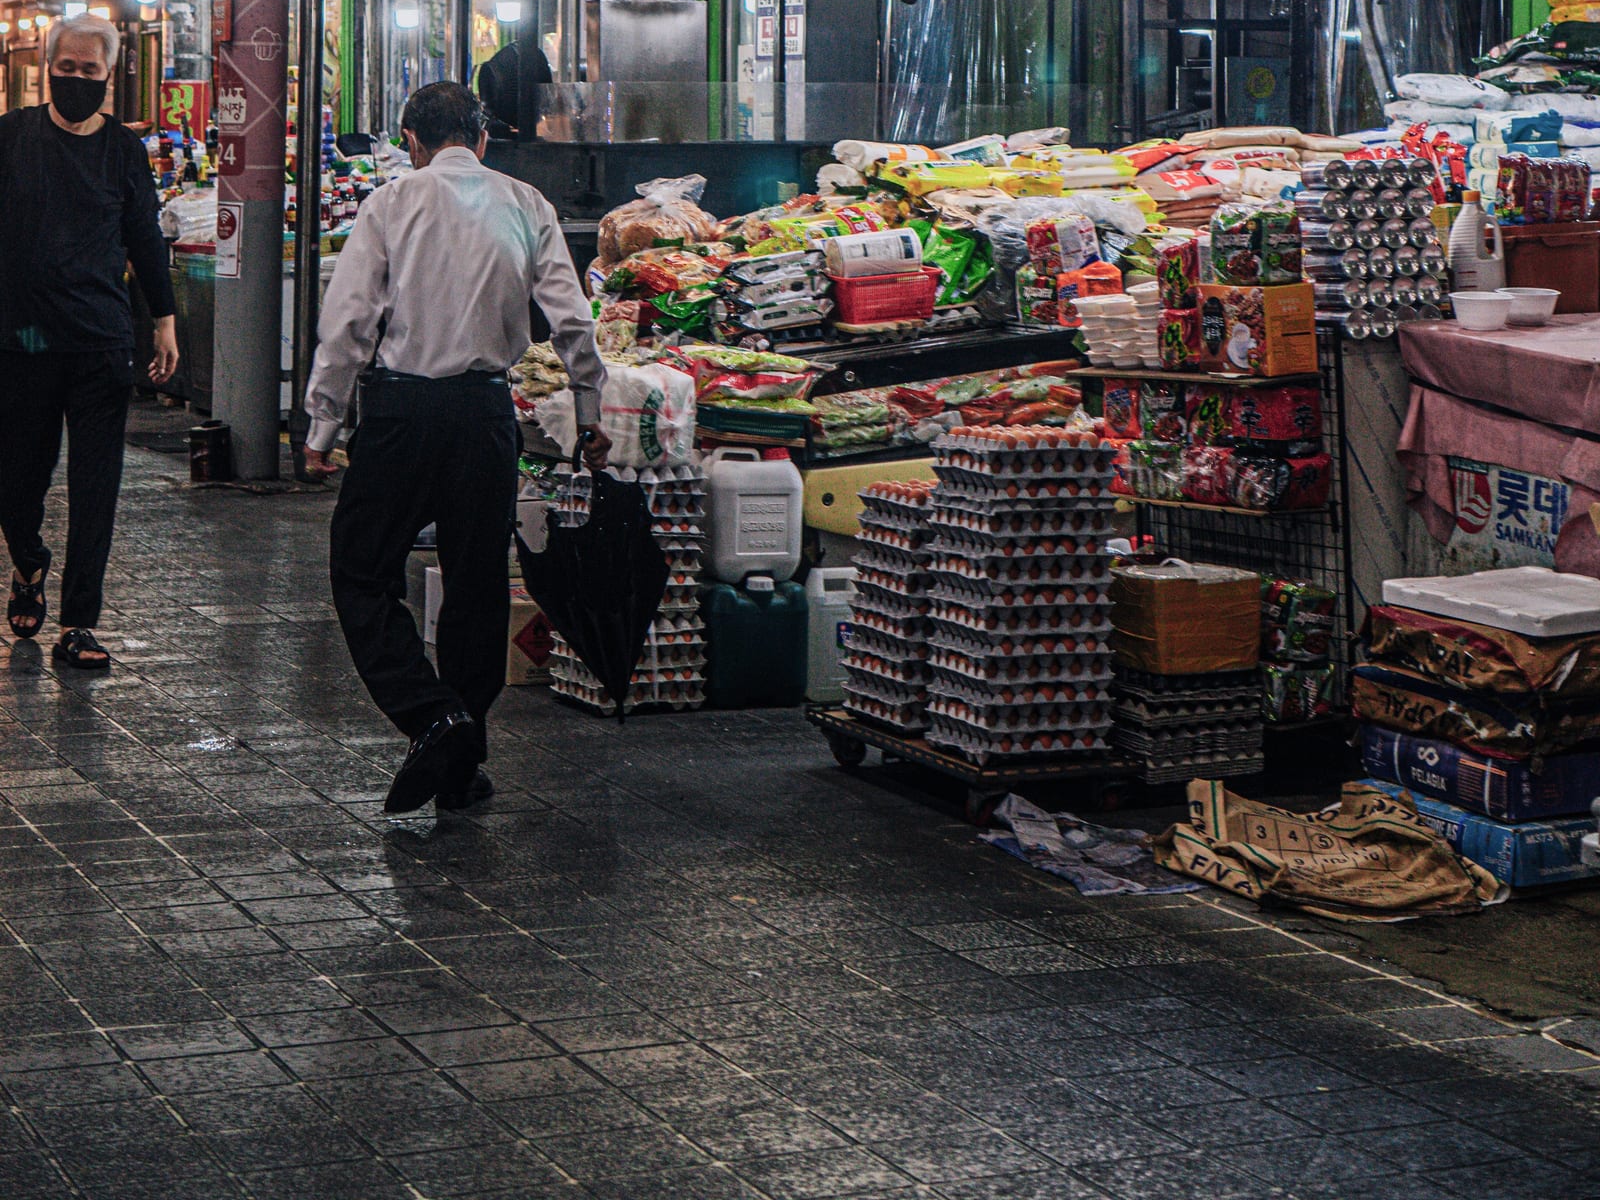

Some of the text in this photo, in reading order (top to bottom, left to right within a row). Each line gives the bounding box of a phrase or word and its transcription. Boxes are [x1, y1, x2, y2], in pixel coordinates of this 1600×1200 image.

[1497, 470, 1568, 535] 롯데
[1256, 825, 1329, 849] 3 4 5
